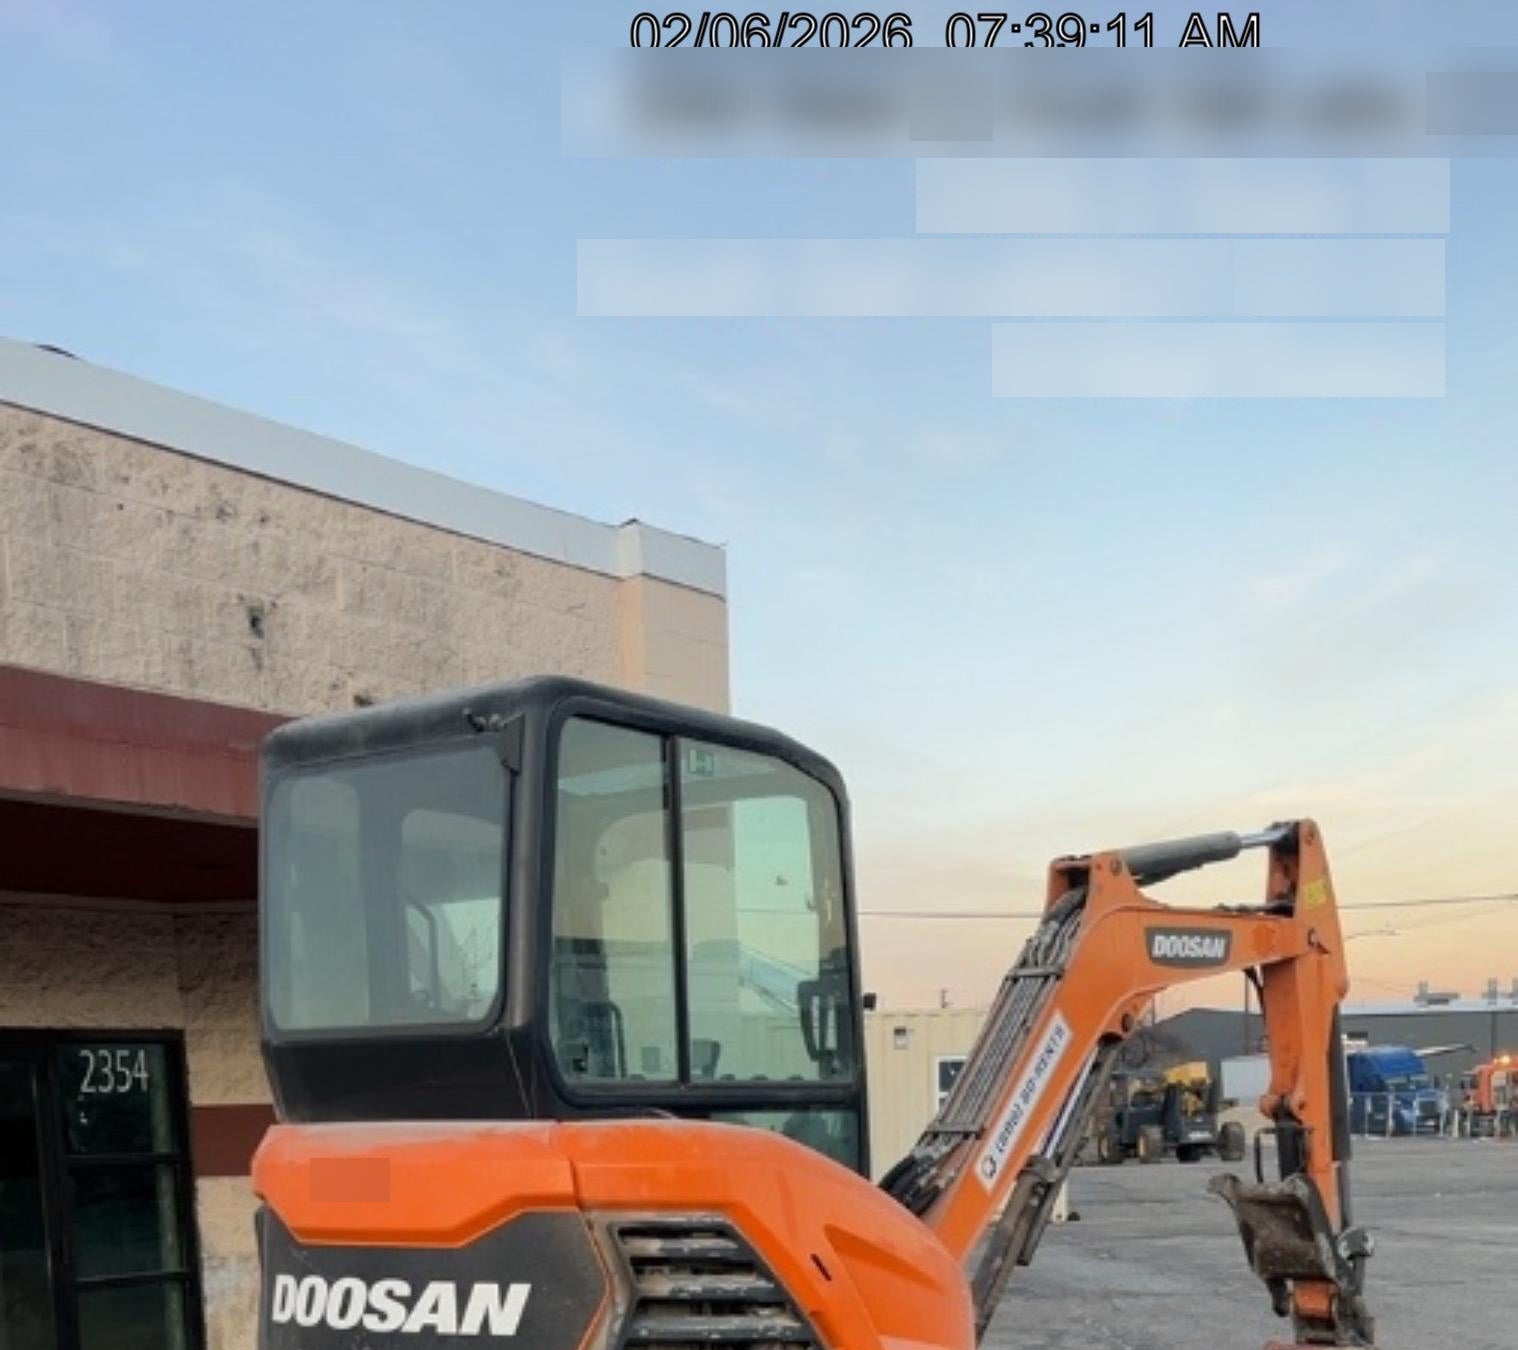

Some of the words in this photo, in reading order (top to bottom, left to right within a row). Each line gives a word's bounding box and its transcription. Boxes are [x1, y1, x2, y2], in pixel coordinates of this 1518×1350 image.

[1151, 934, 1226, 959] DOOSAN
[79, 1049, 149, 1093] 2354
[271, 1273, 532, 1336] DOOSAN
